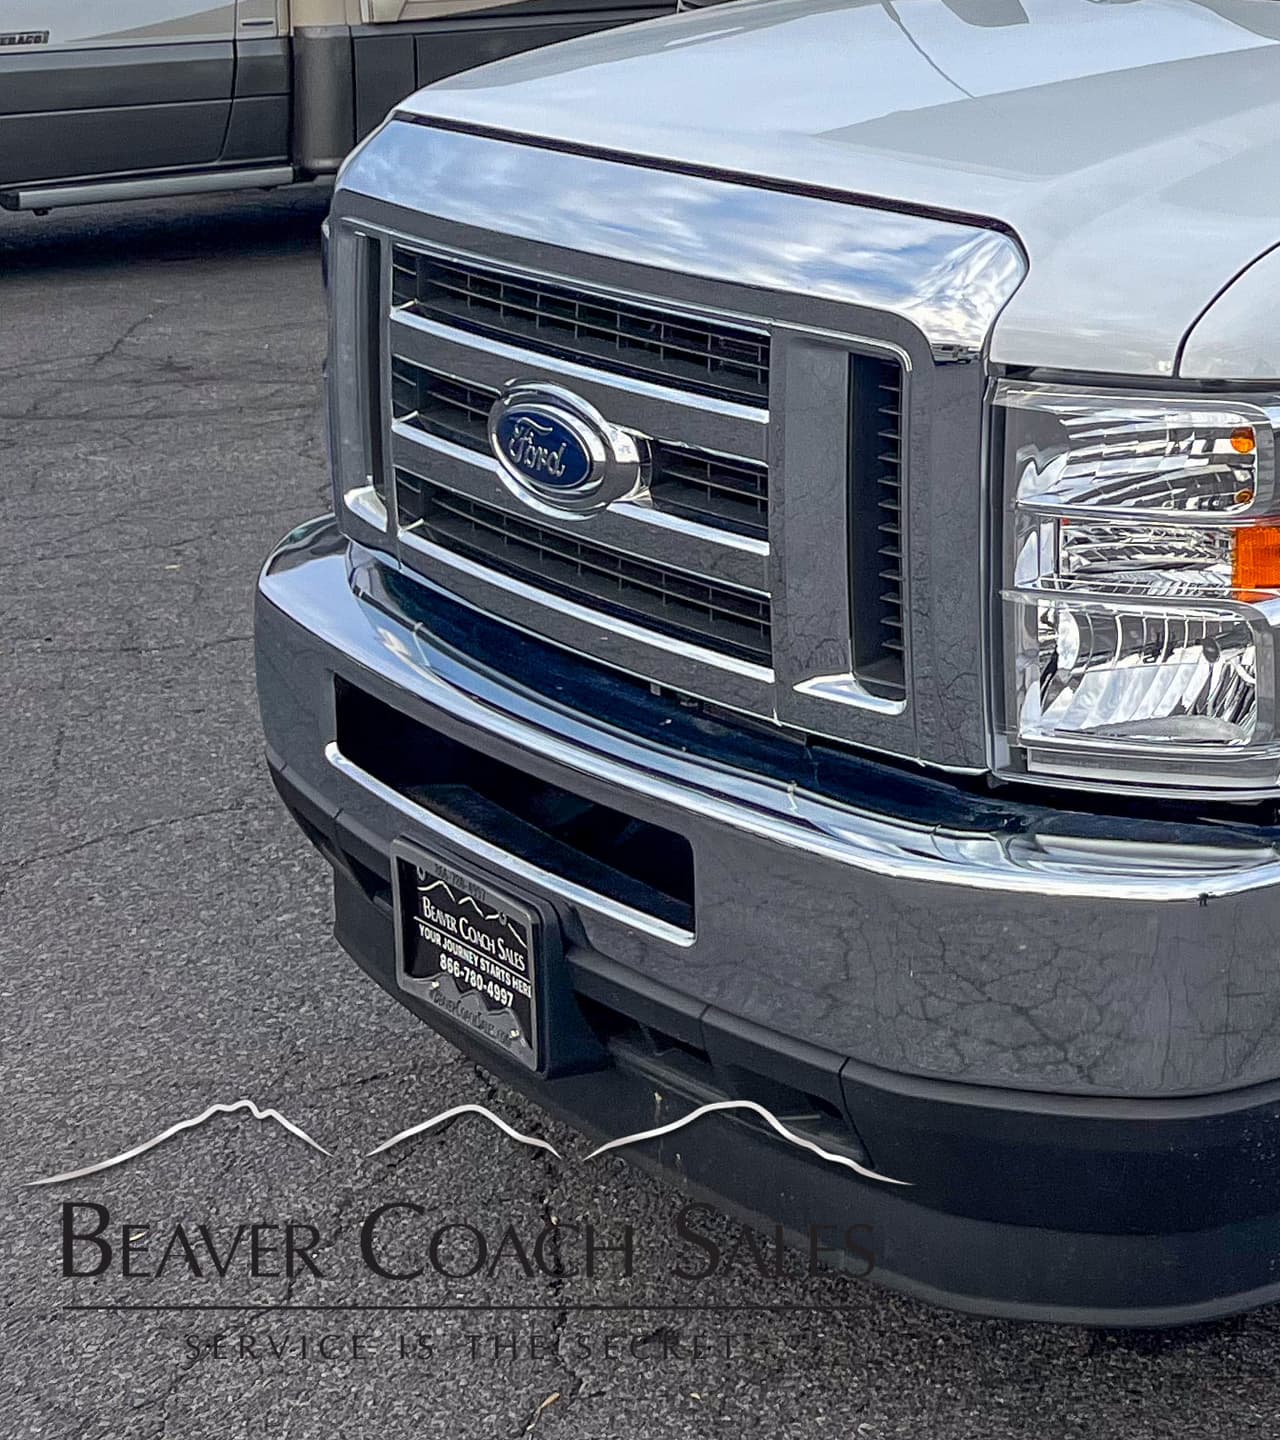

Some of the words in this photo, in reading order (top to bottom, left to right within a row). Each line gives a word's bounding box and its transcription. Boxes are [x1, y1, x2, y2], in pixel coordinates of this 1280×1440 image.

[508, 416, 569, 478] Ford
[418, 923, 442, 951] YOUR
[442, 937, 480, 968] JOURNEY
[480, 954, 512, 986] STARTS
[458, 917, 496, 956] COACH
[497, 937, 526, 972] SALES
[439, 952, 515, 1009] 866-780-4997
